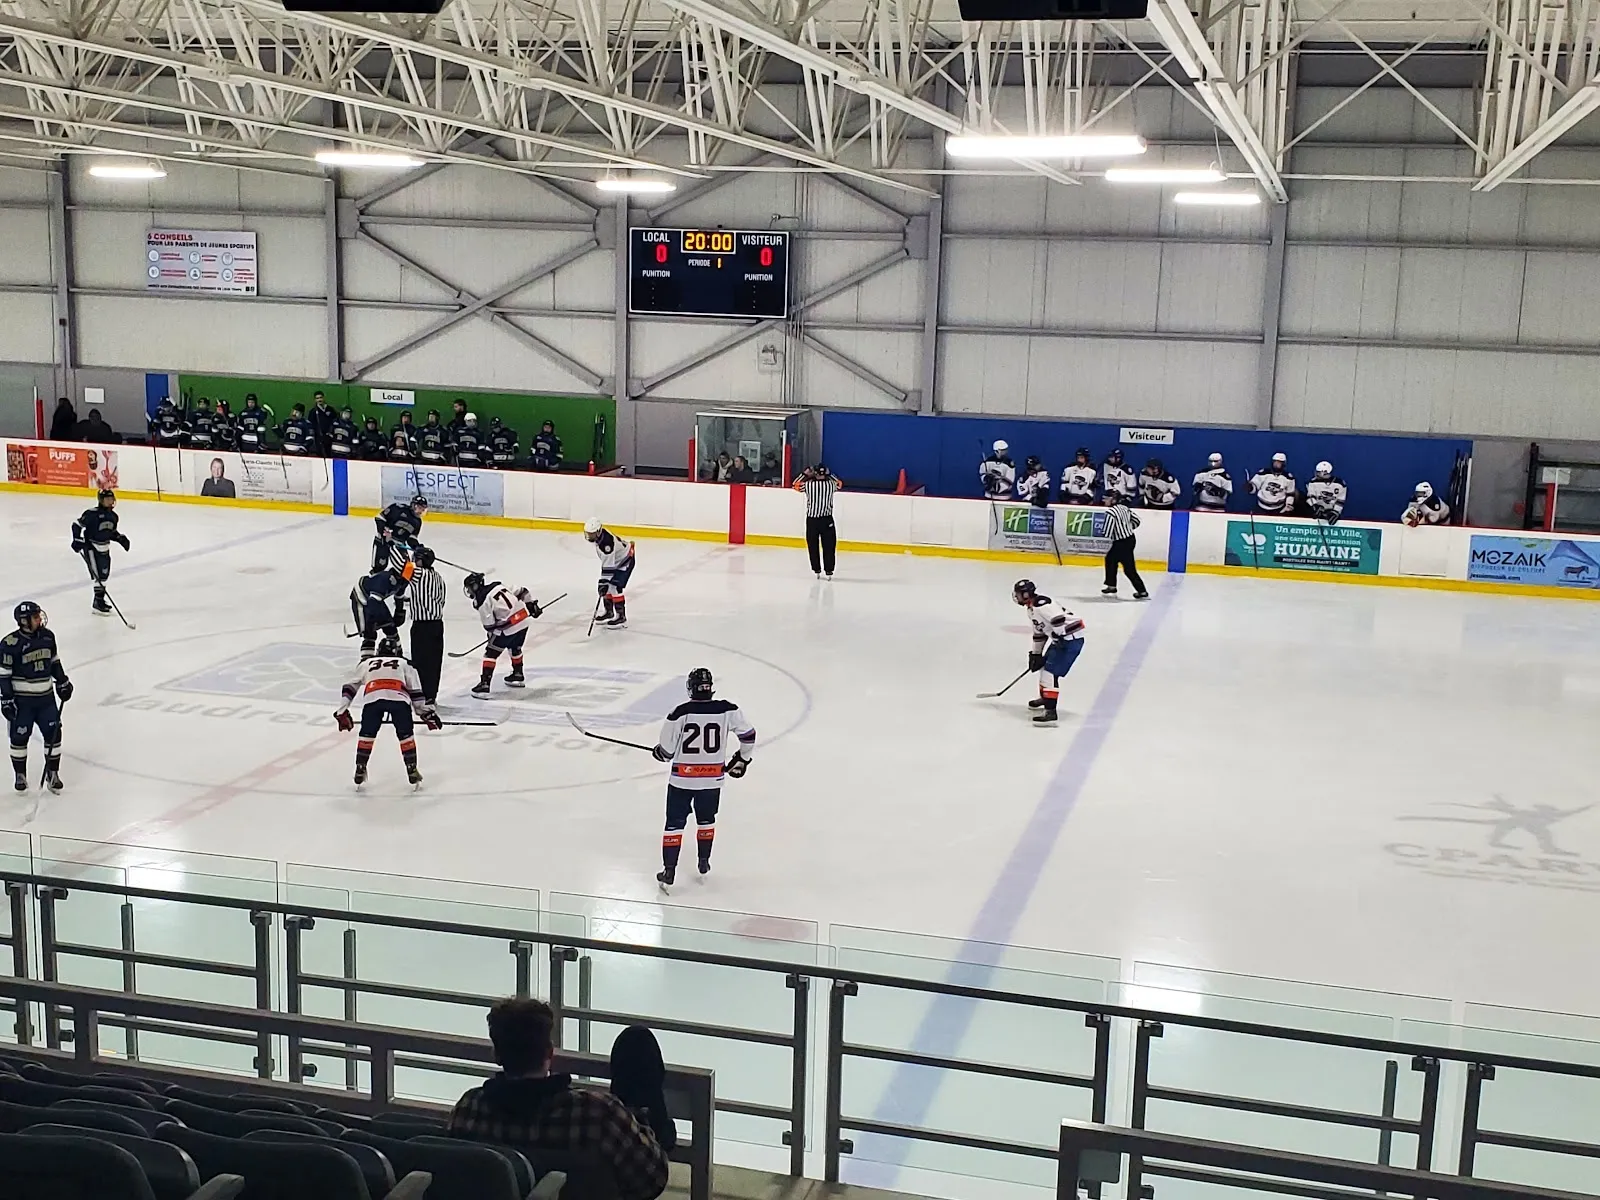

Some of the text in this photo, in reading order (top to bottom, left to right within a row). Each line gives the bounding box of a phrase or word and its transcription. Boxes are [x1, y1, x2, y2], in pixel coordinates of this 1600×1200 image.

[153, 233, 193, 241] CONSEILS
[642, 232, 670, 243] LOCAL
[684, 232, 732, 251] 20:00
[742, 235, 783, 246] VISITEUR
[655, 244, 668, 263] 0
[760, 247, 773, 266] 0
[642, 270, 670, 278] PUNITION
[744, 273, 773, 281] PUNITION
[382, 392, 403, 401] Local
[1128, 430, 1166, 442] Visiteur
[49, 450, 76, 462] PUFFS
[405, 471, 480, 493] RESPECT
[1275, 525, 1289, 533] Un
[1290, 527, 1320, 536] emploi
[1330, 528, 1339, 536] la
[1273, 542, 1361, 559] HUMAINE
[1471, 549, 1547, 567] MOZAIK
[493, 588, 514, 610] 7
[368, 659, 400, 672] 34
[682, 722, 721, 754] 20
